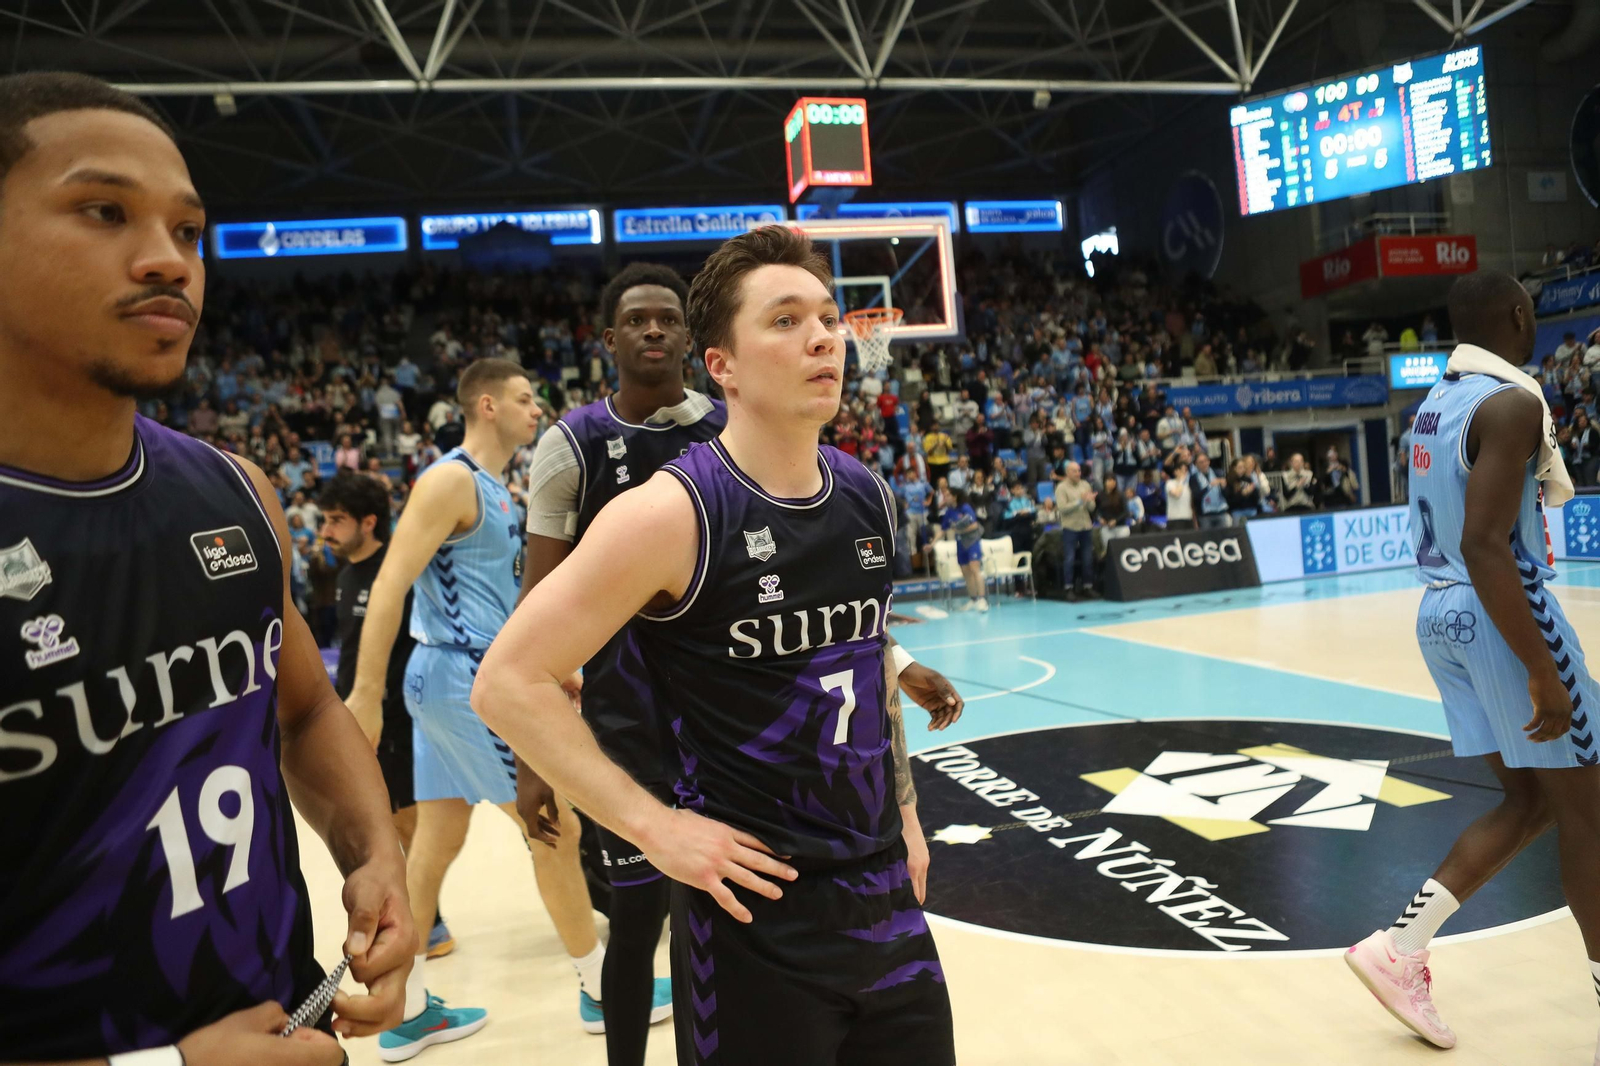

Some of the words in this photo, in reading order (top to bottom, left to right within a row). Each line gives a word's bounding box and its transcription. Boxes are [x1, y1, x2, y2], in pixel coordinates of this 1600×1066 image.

[1315, 81, 1348, 105] 100
[806, 103, 866, 125] 00:00
[1338, 101, 1363, 122] 4T
[1320, 125, 1382, 158] 00:00
[625, 214, 692, 235] Estrella
[1253, 387, 1301, 405] ribera
[1413, 443, 1431, 470] Río
[203, 545, 228, 560] liga
[210, 553, 253, 572] endesa
[860, 548, 873, 558] liga
[863, 555, 885, 565] endesa
[1120, 537, 1243, 573] endesa
[1345, 542, 1373, 566] DE
[760, 591, 783, 602] hummel
[29, 642, 77, 667] hummel
[818, 668, 854, 746] 7
[145, 764, 255, 920] 19
[916, 745, 1040, 808] TORRE
[1010, 802, 1072, 834] DE
[1047, 827, 1290, 952] NÚÑEZ
[617, 858, 629, 866] EL
